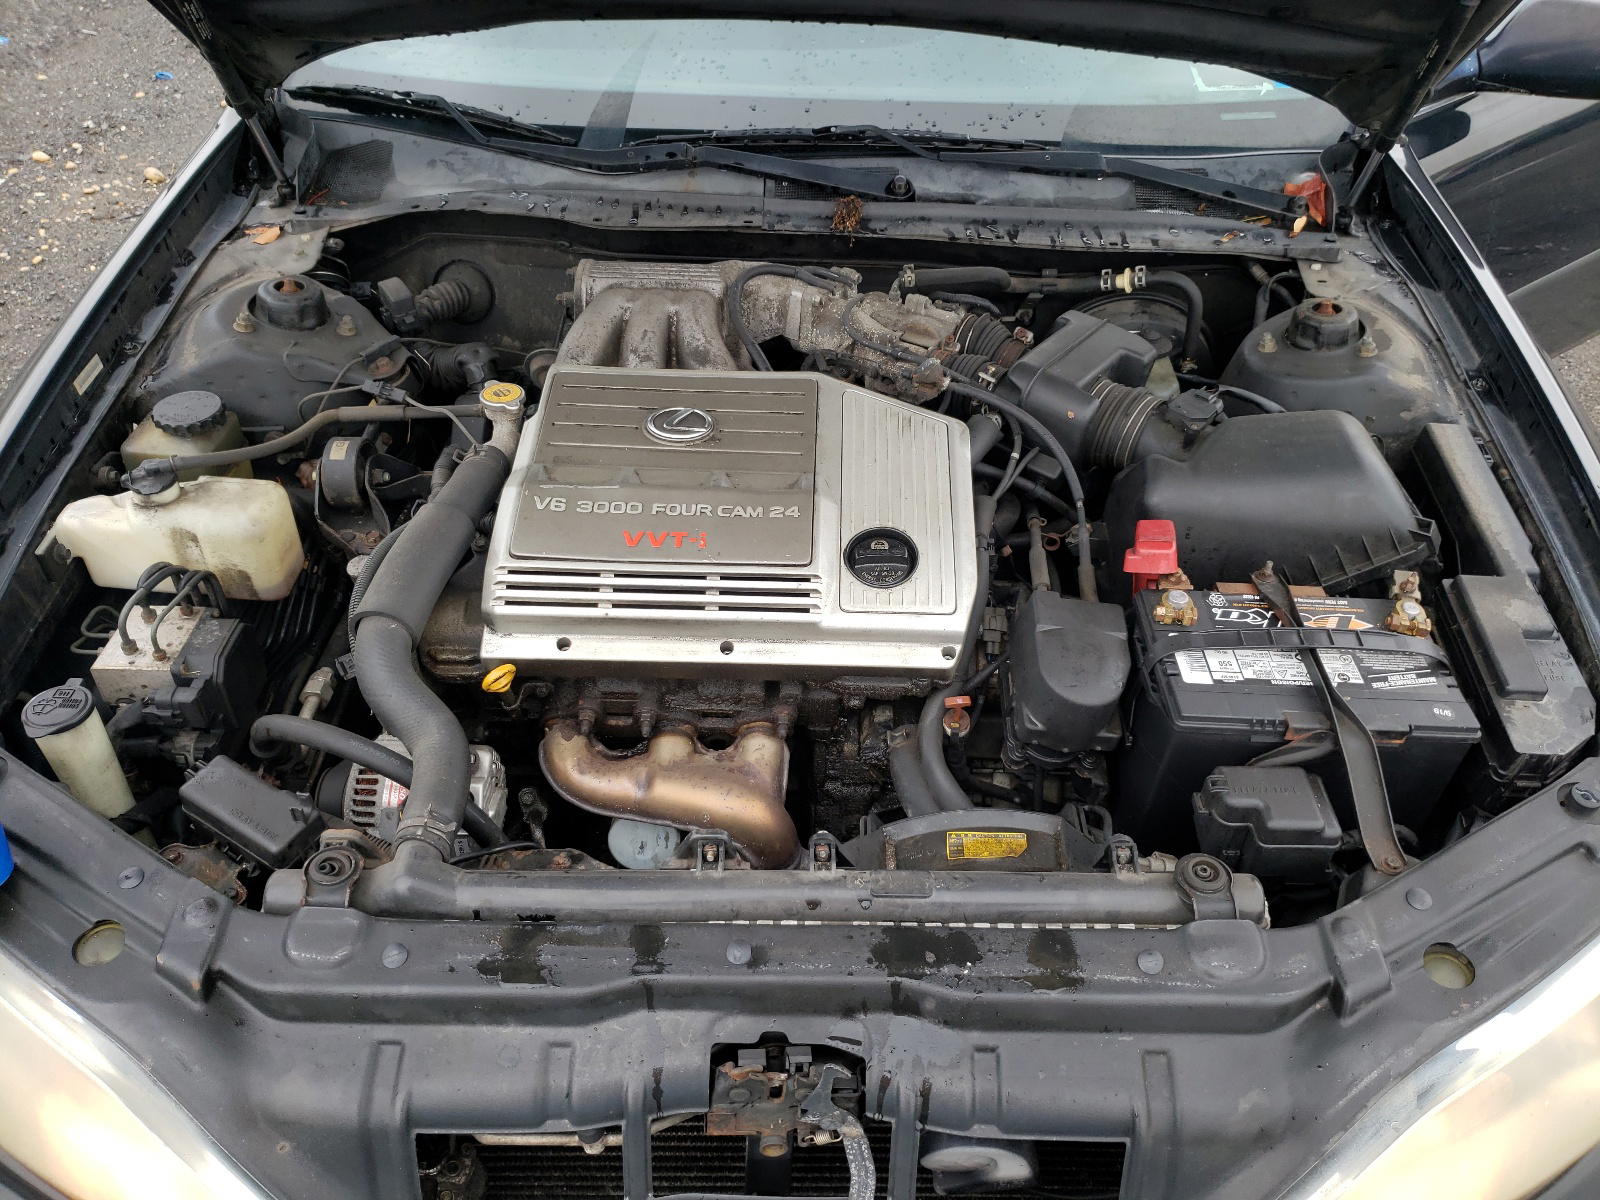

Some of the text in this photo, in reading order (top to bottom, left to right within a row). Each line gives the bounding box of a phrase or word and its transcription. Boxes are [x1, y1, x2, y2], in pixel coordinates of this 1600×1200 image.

[534, 495, 801, 518] V6 3000 FOUR CAM 24
[623, 530, 708, 549] VVT-i
